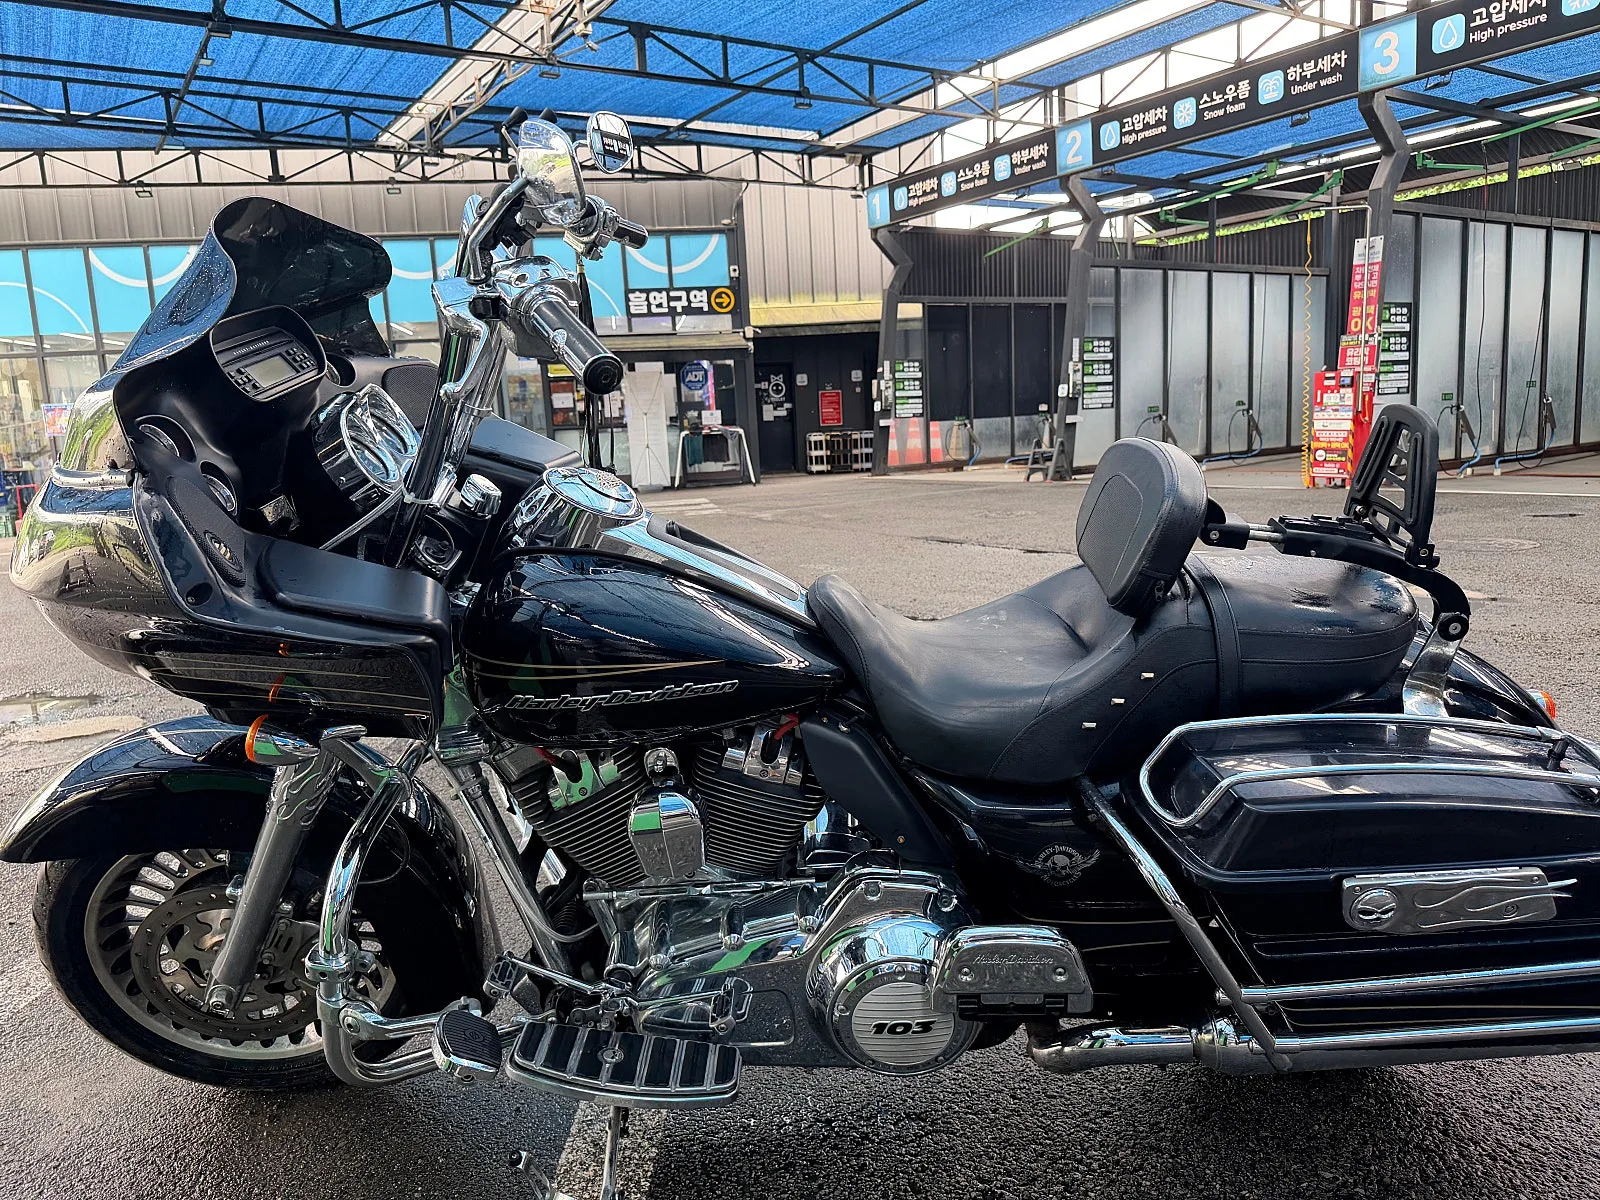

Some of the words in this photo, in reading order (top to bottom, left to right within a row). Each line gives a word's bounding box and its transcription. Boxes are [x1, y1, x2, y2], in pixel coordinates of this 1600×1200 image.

[1469, 27, 1494, 43] High
[1497, 12, 1548, 38] pressure
[1286, 50, 1347, 82] 하부세차
[1373, 31, 1400, 76] 3
[1199, 79, 1251, 109] 스노우폼
[1290, 81, 1317, 96] Under
[1319, 72, 1342, 87] wash
[1121, 105, 1168, 132] 고압세차
[1203, 107, 1225, 121] Snow
[1226, 102, 1246, 115] foam
[1066, 130, 1083, 165] 2
[1121, 132, 1137, 145] High
[1138, 125, 1167, 142] pressure
[1011, 143, 1049, 166] 하부세차
[957, 160, 990, 182] 스노우폼
[872, 193, 881, 220] 1
[628, 289, 709, 314] 흡연구역
[685, 371, 705, 382] ADT
[505, 679, 739, 712] Harley-Davidson
[870, 1019, 937, 1036] 103
